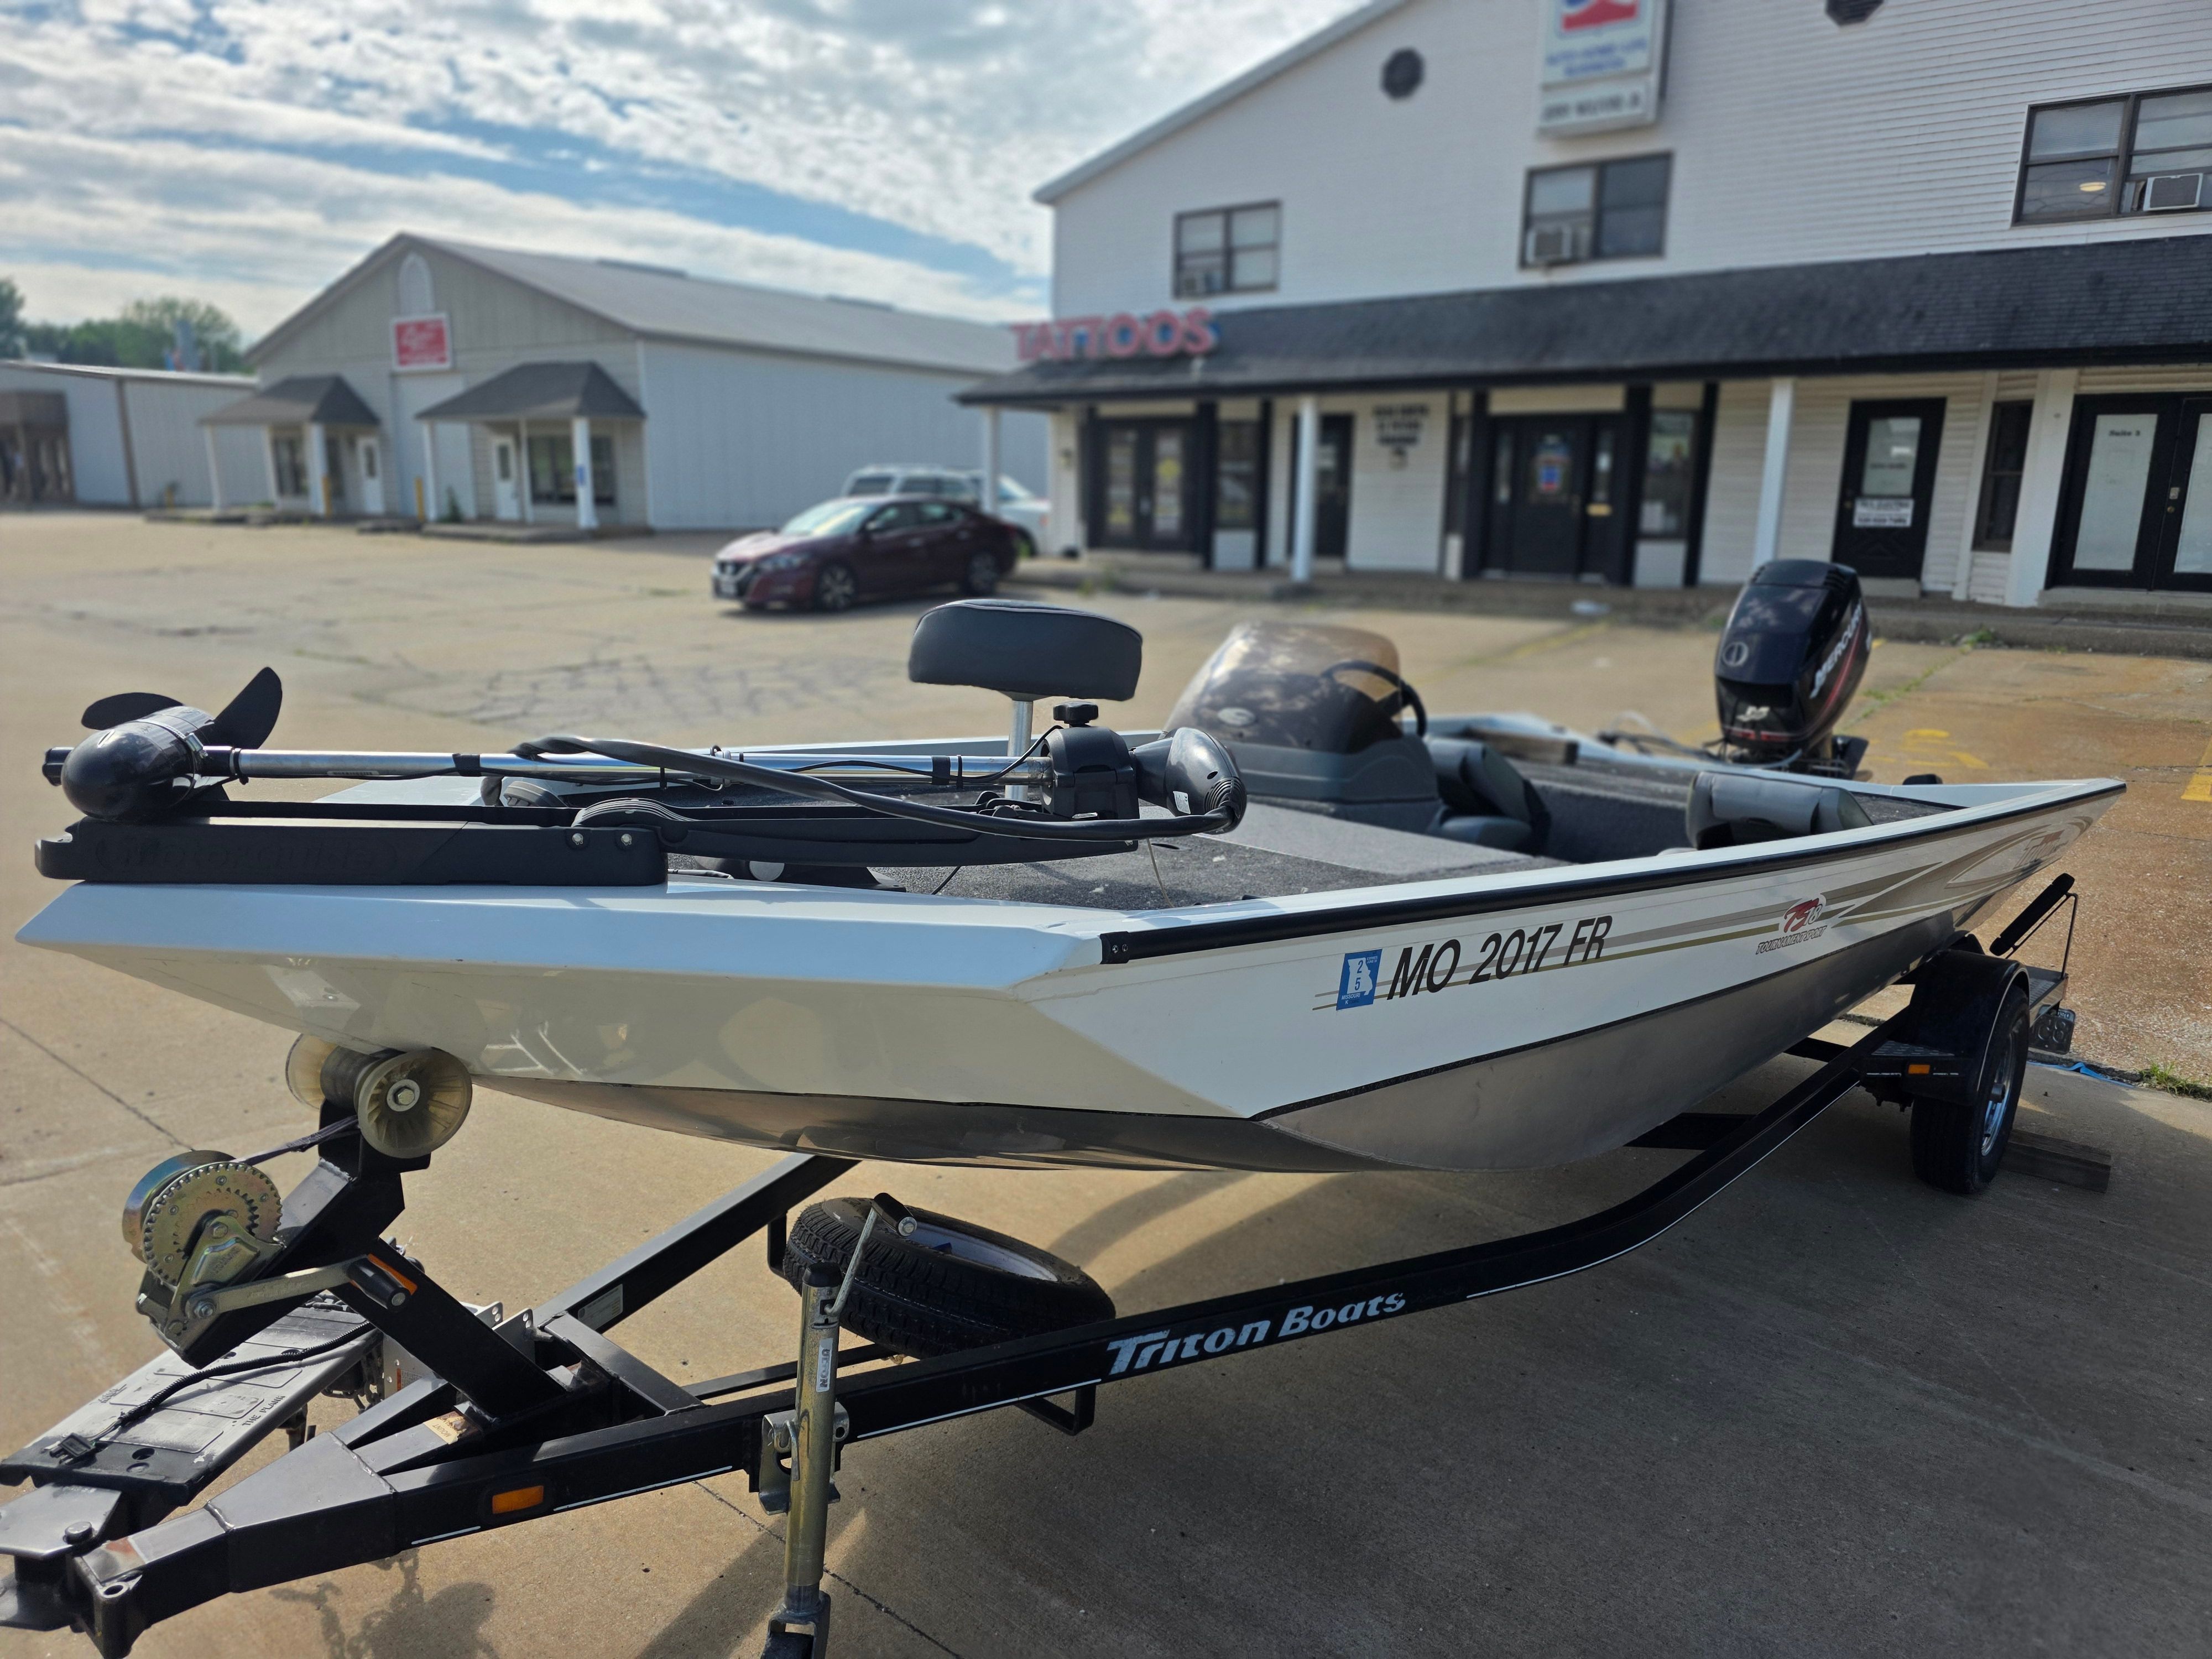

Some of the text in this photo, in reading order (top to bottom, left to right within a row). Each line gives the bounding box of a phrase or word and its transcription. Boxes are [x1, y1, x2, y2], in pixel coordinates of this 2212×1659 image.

[1010, 306, 1214, 361] TATTOOS
[1387, 915, 1613, 1000] MO 2017 FR
[1755, 925, 1828, 955] TOURNAMENT SPORT
[1107, 1292, 1406, 1375] Triton Boats
